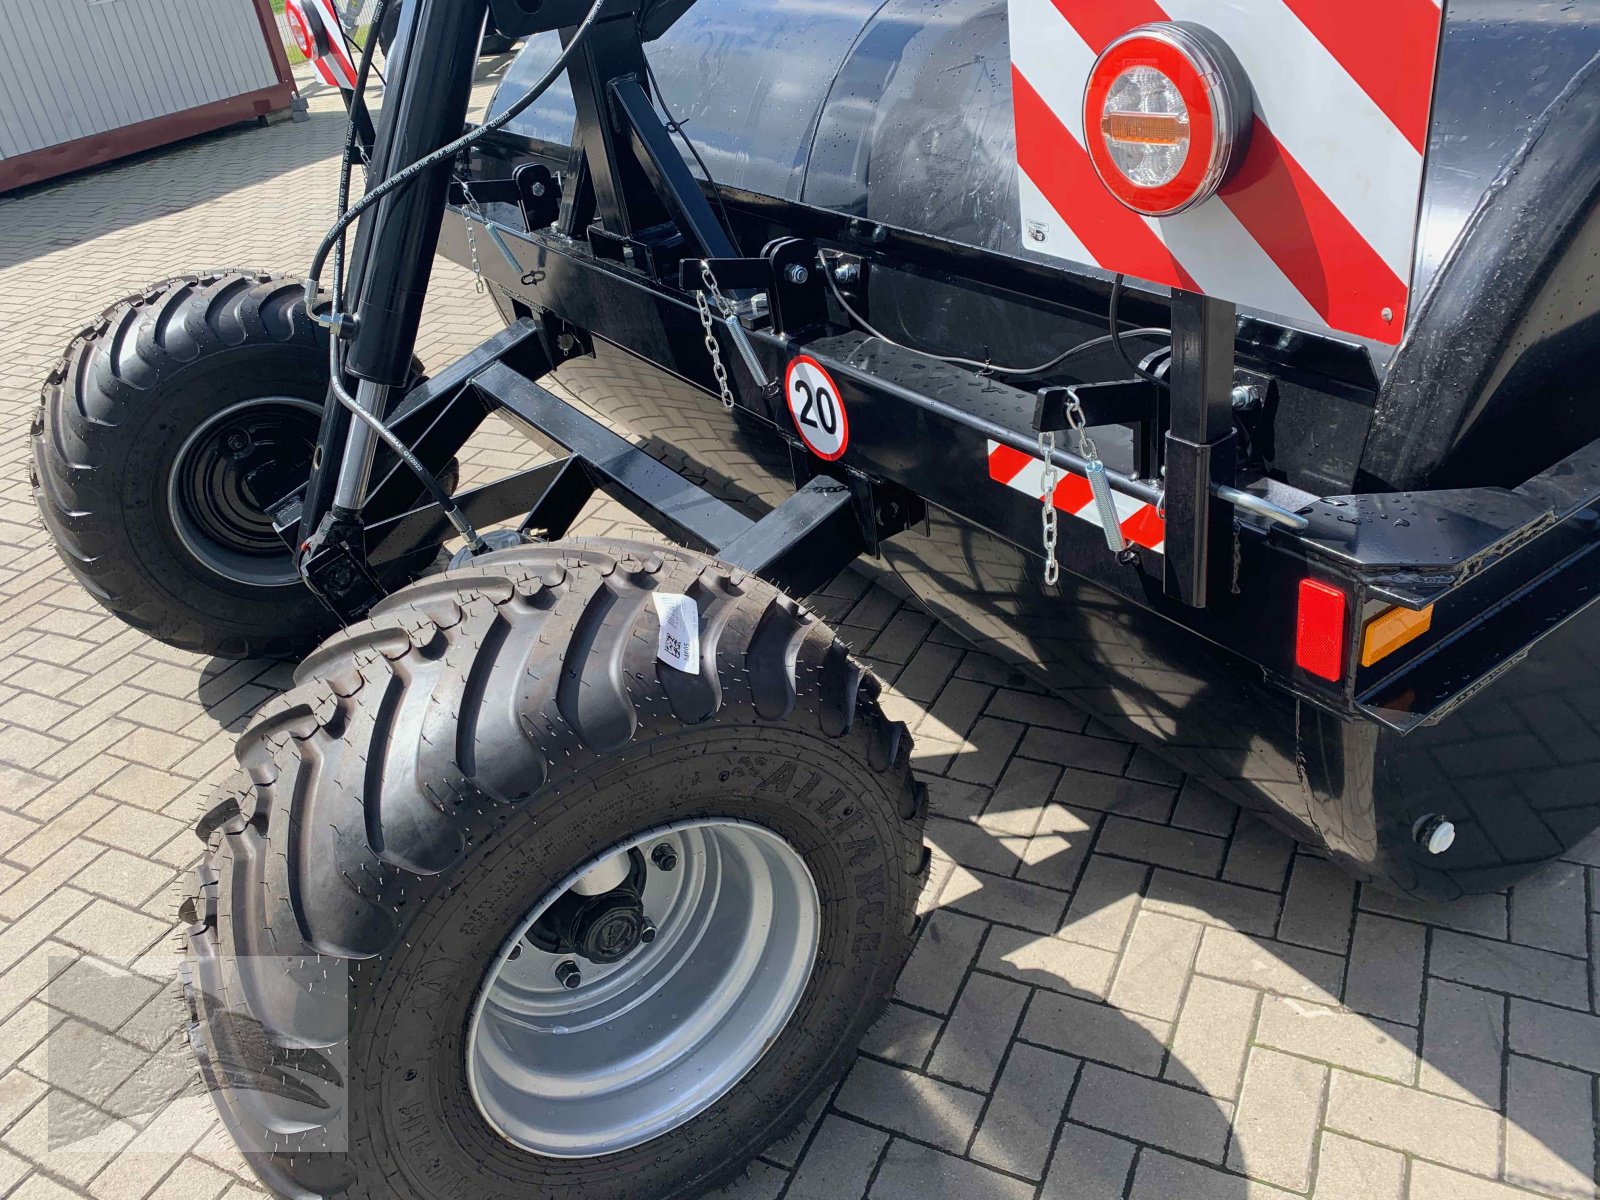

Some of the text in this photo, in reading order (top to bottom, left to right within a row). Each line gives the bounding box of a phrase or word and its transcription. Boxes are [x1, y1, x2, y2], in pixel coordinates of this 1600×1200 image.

[794, 379, 837, 435] 20
[403, 450, 423, 472] Q1/2022
[757, 760, 885, 952] ALLIANCE
